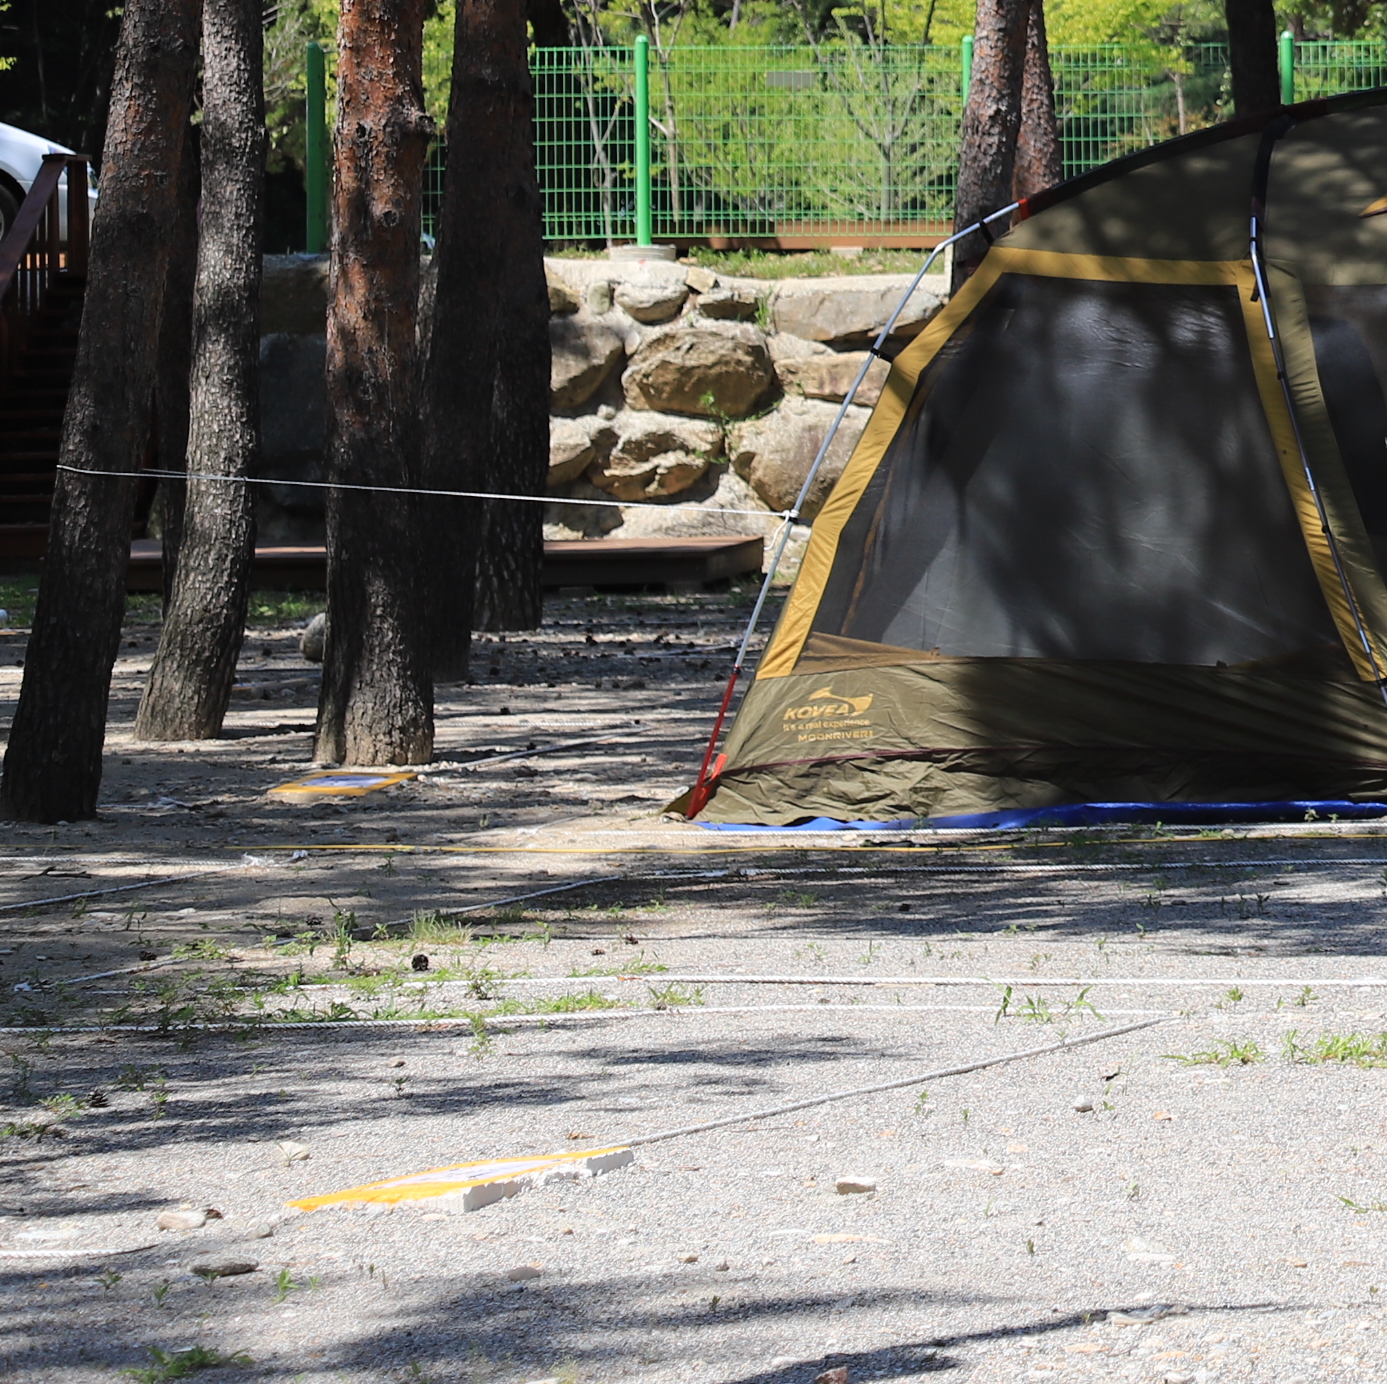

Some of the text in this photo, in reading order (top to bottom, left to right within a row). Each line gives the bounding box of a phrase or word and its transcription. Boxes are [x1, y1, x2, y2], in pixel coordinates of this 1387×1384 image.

[783, 703, 850, 720] KOVEA
[805, 720, 822, 730] real
[823, 718, 870, 729] experience
